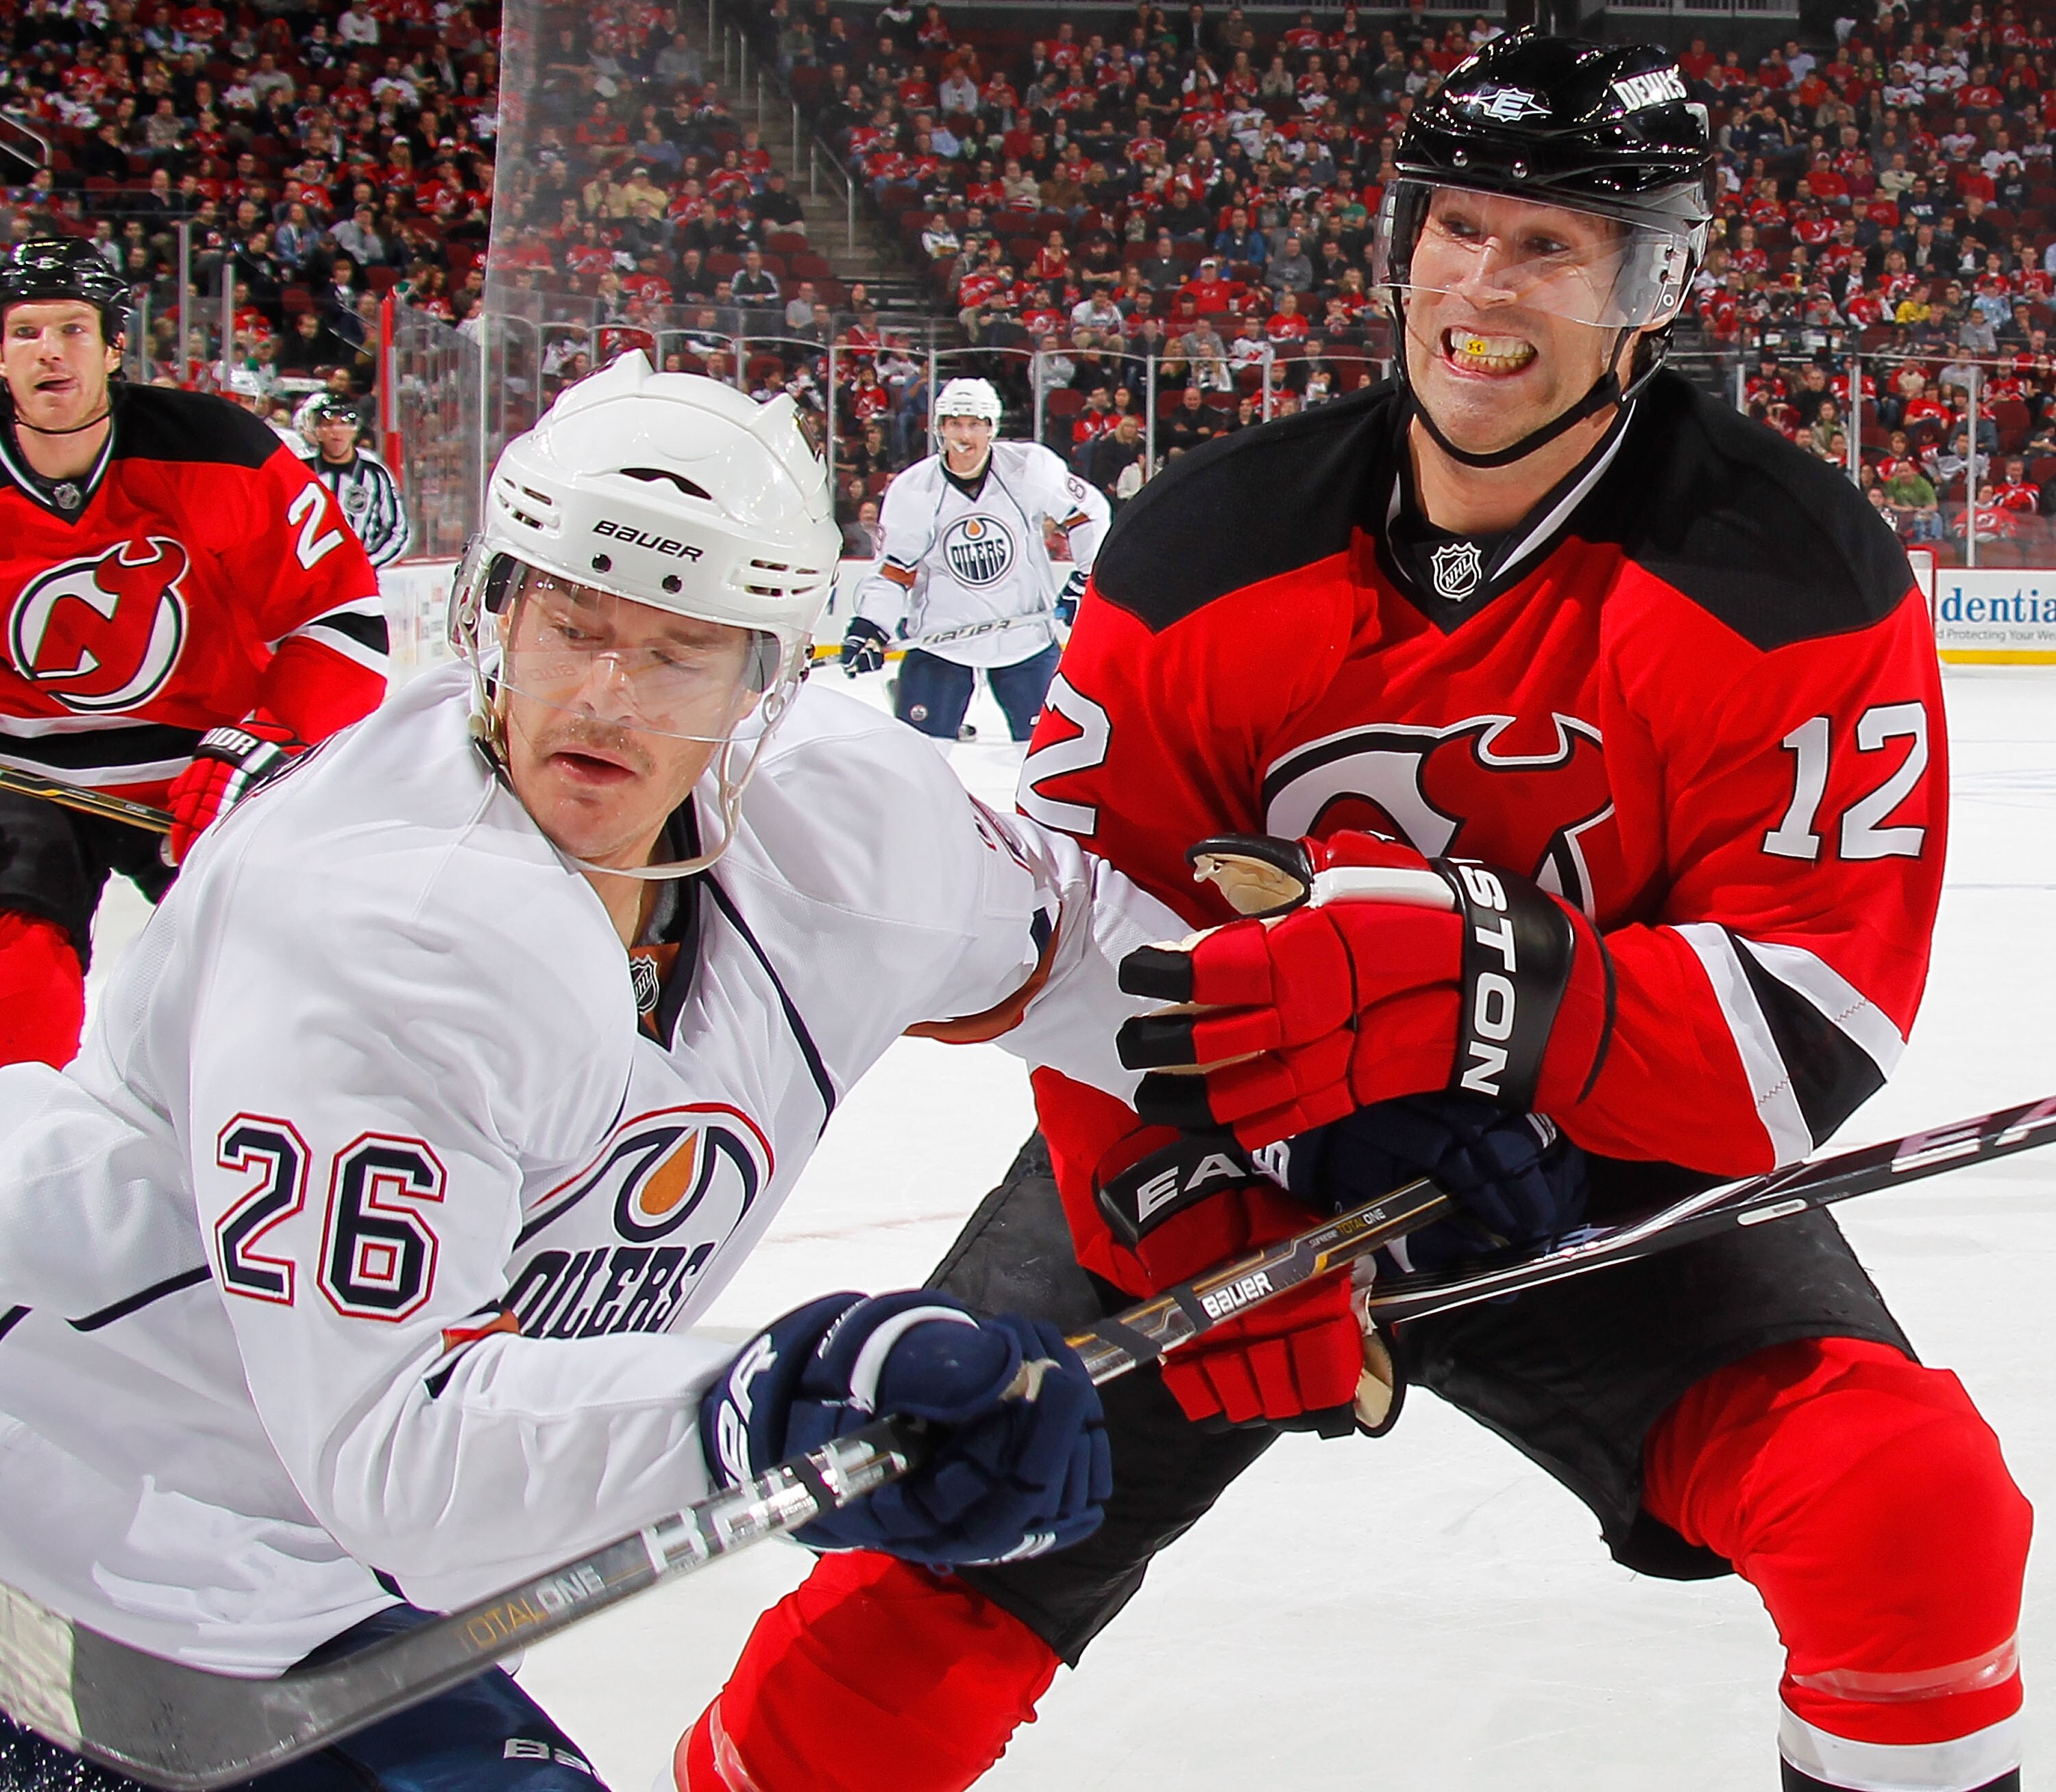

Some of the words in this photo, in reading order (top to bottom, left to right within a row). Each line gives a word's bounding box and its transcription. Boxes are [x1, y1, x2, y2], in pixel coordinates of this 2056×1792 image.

[286, 482, 345, 570] 2
[949, 538, 1007, 580] OILERS
[1445, 557, 1471, 589] NHL
[1942, 587, 2056, 623] dentia
[1947, 629, 2006, 643] Protecting
[2009, 629, 2034, 640] Your
[1762, 700, 1929, 862] 12
[1449, 857, 1517, 1096] STON
[215, 1112, 448, 1323] 26
[1137, 1153, 1247, 1223] EA
[500, 1242, 718, 1338] OILERS
